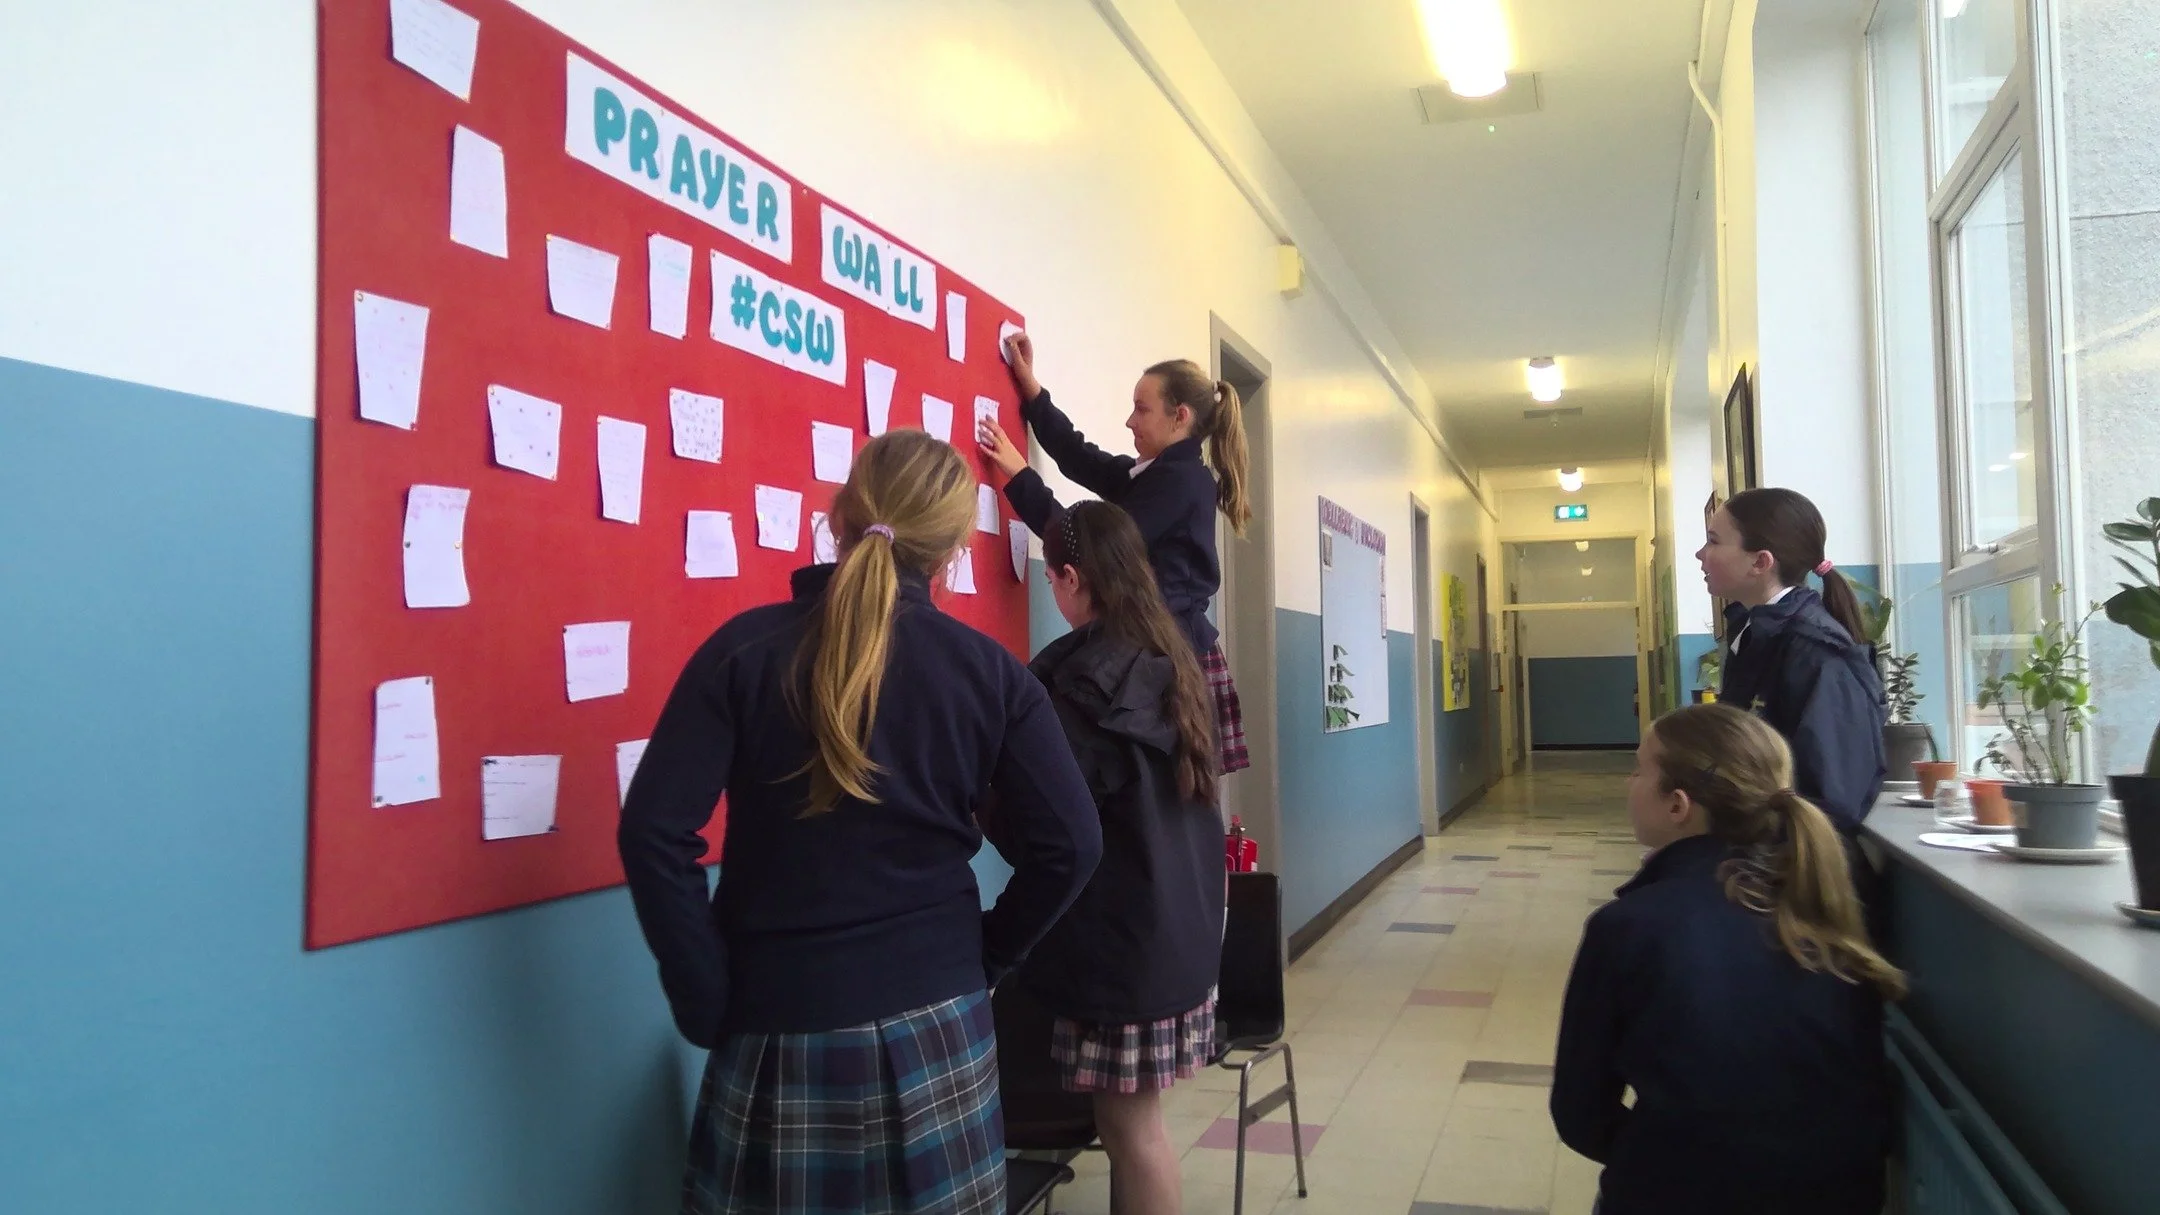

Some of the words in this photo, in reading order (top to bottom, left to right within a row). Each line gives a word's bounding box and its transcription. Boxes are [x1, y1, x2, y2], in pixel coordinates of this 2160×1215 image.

[594, 88, 779, 241] PRAYER
[834, 226, 923, 312] WALL
[730, 275, 834, 365] #CSW
